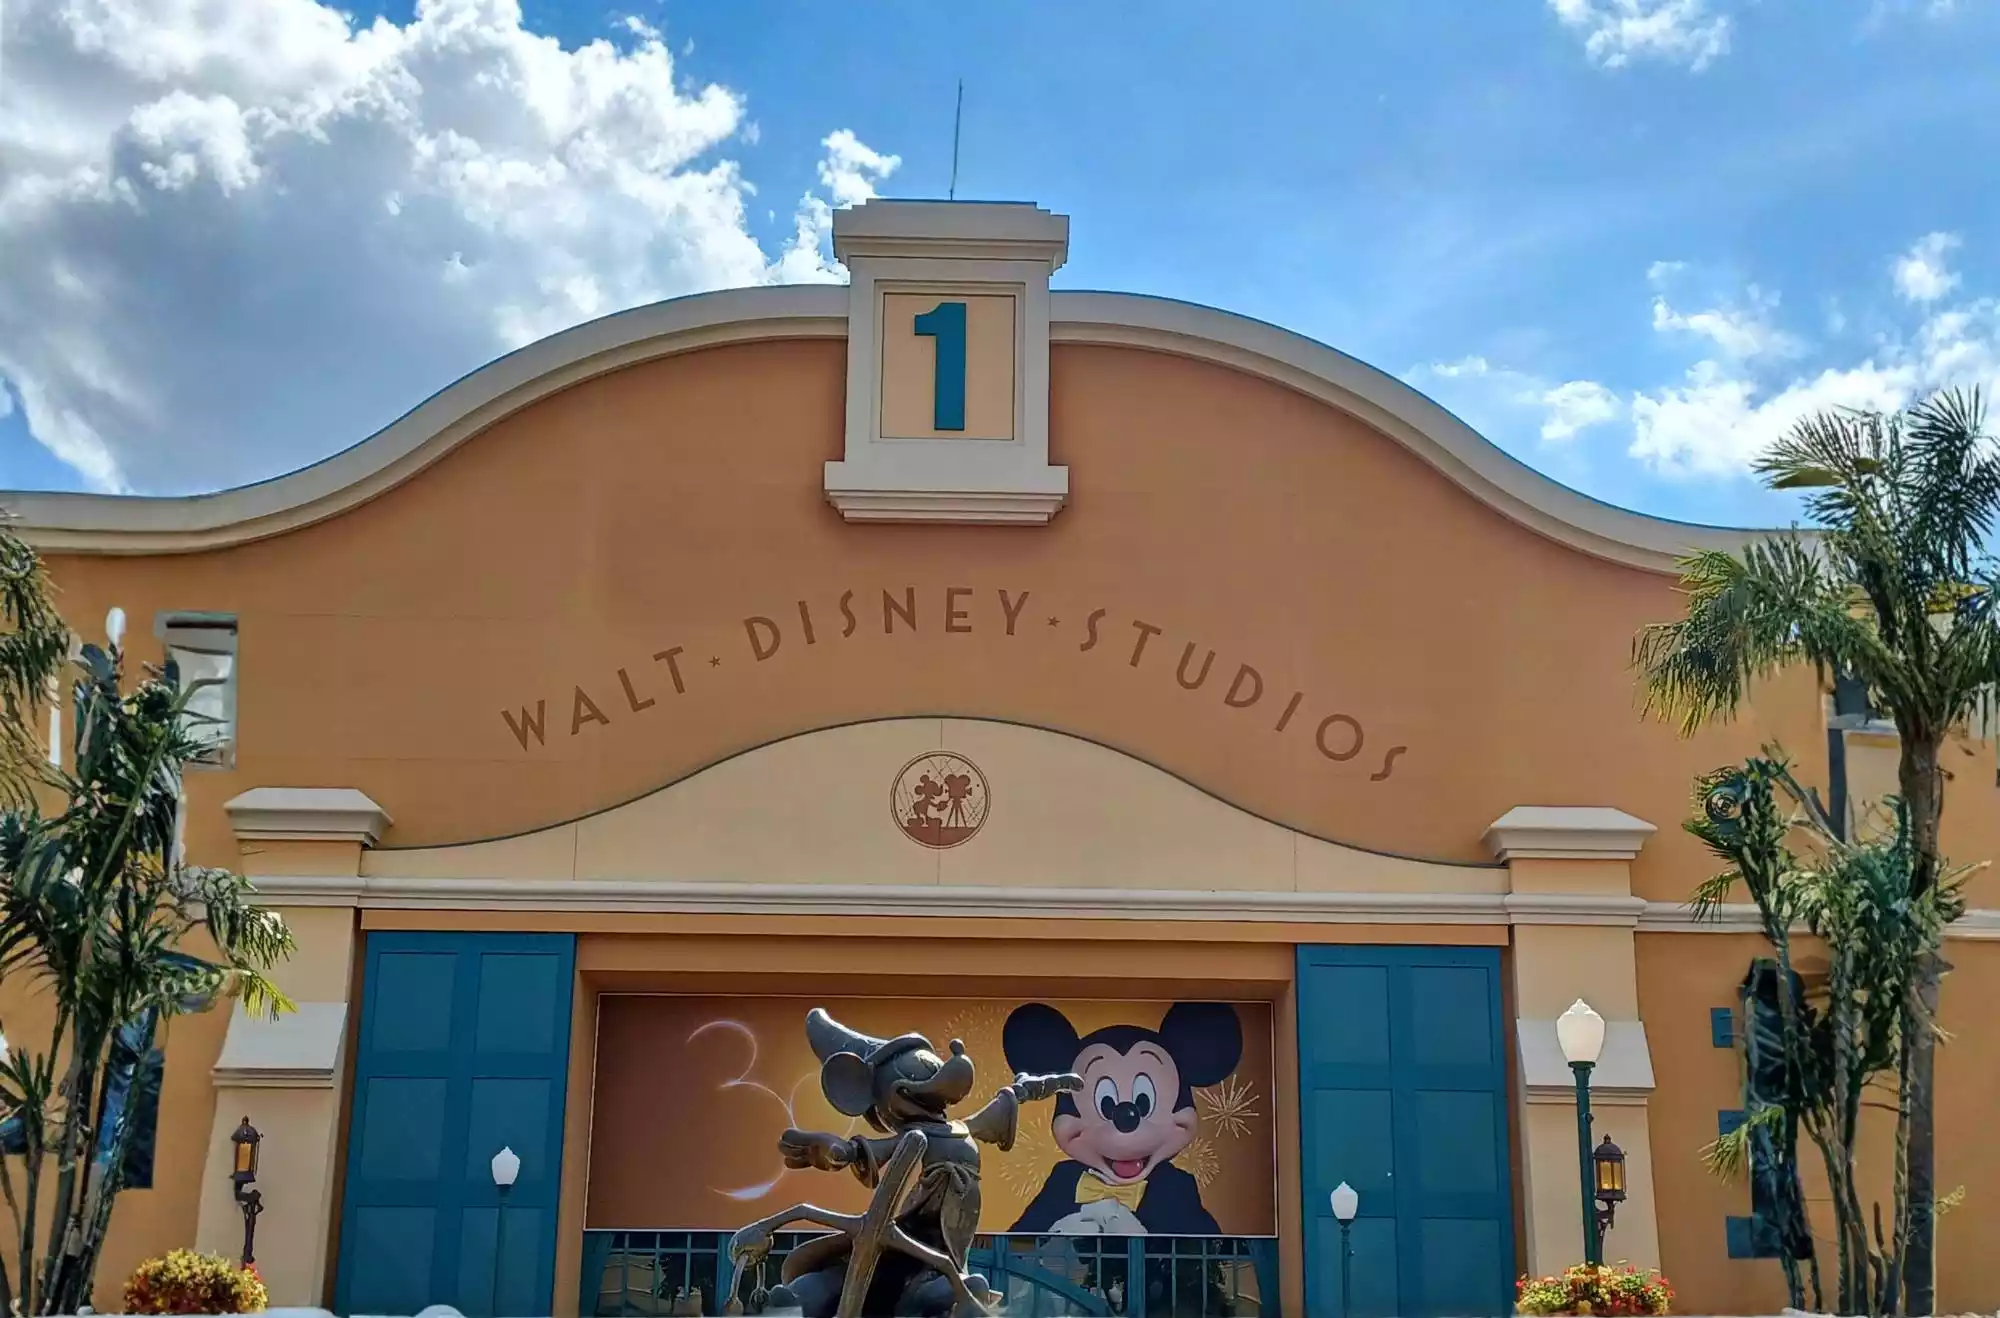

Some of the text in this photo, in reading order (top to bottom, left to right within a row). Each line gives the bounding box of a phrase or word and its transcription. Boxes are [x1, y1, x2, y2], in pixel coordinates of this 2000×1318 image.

[914, 302, 966, 431] 1
[501, 586, 1408, 782] WALT DISNEY STUDIOS
